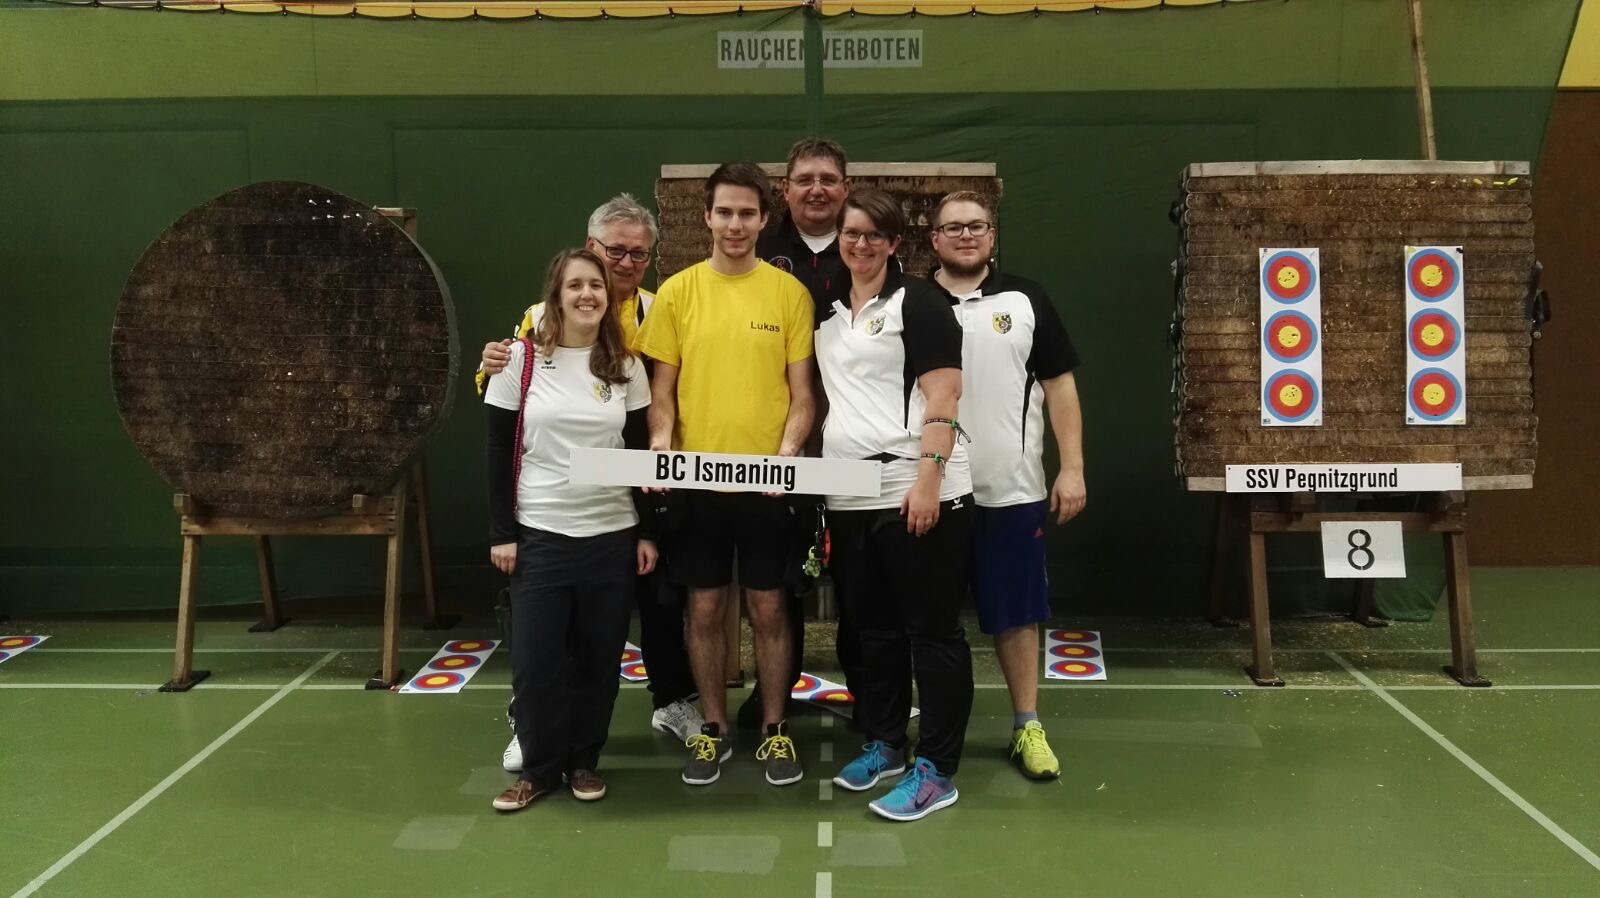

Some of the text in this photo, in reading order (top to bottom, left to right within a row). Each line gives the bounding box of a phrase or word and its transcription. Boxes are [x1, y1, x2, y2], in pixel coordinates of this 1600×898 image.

[750, 321, 781, 332] Lukas
[655, 453, 796, 492] BC Ismaning
[1246, 468, 1398, 492] SSV Pegnitzgrund
[1347, 529, 1375, 571] 8
